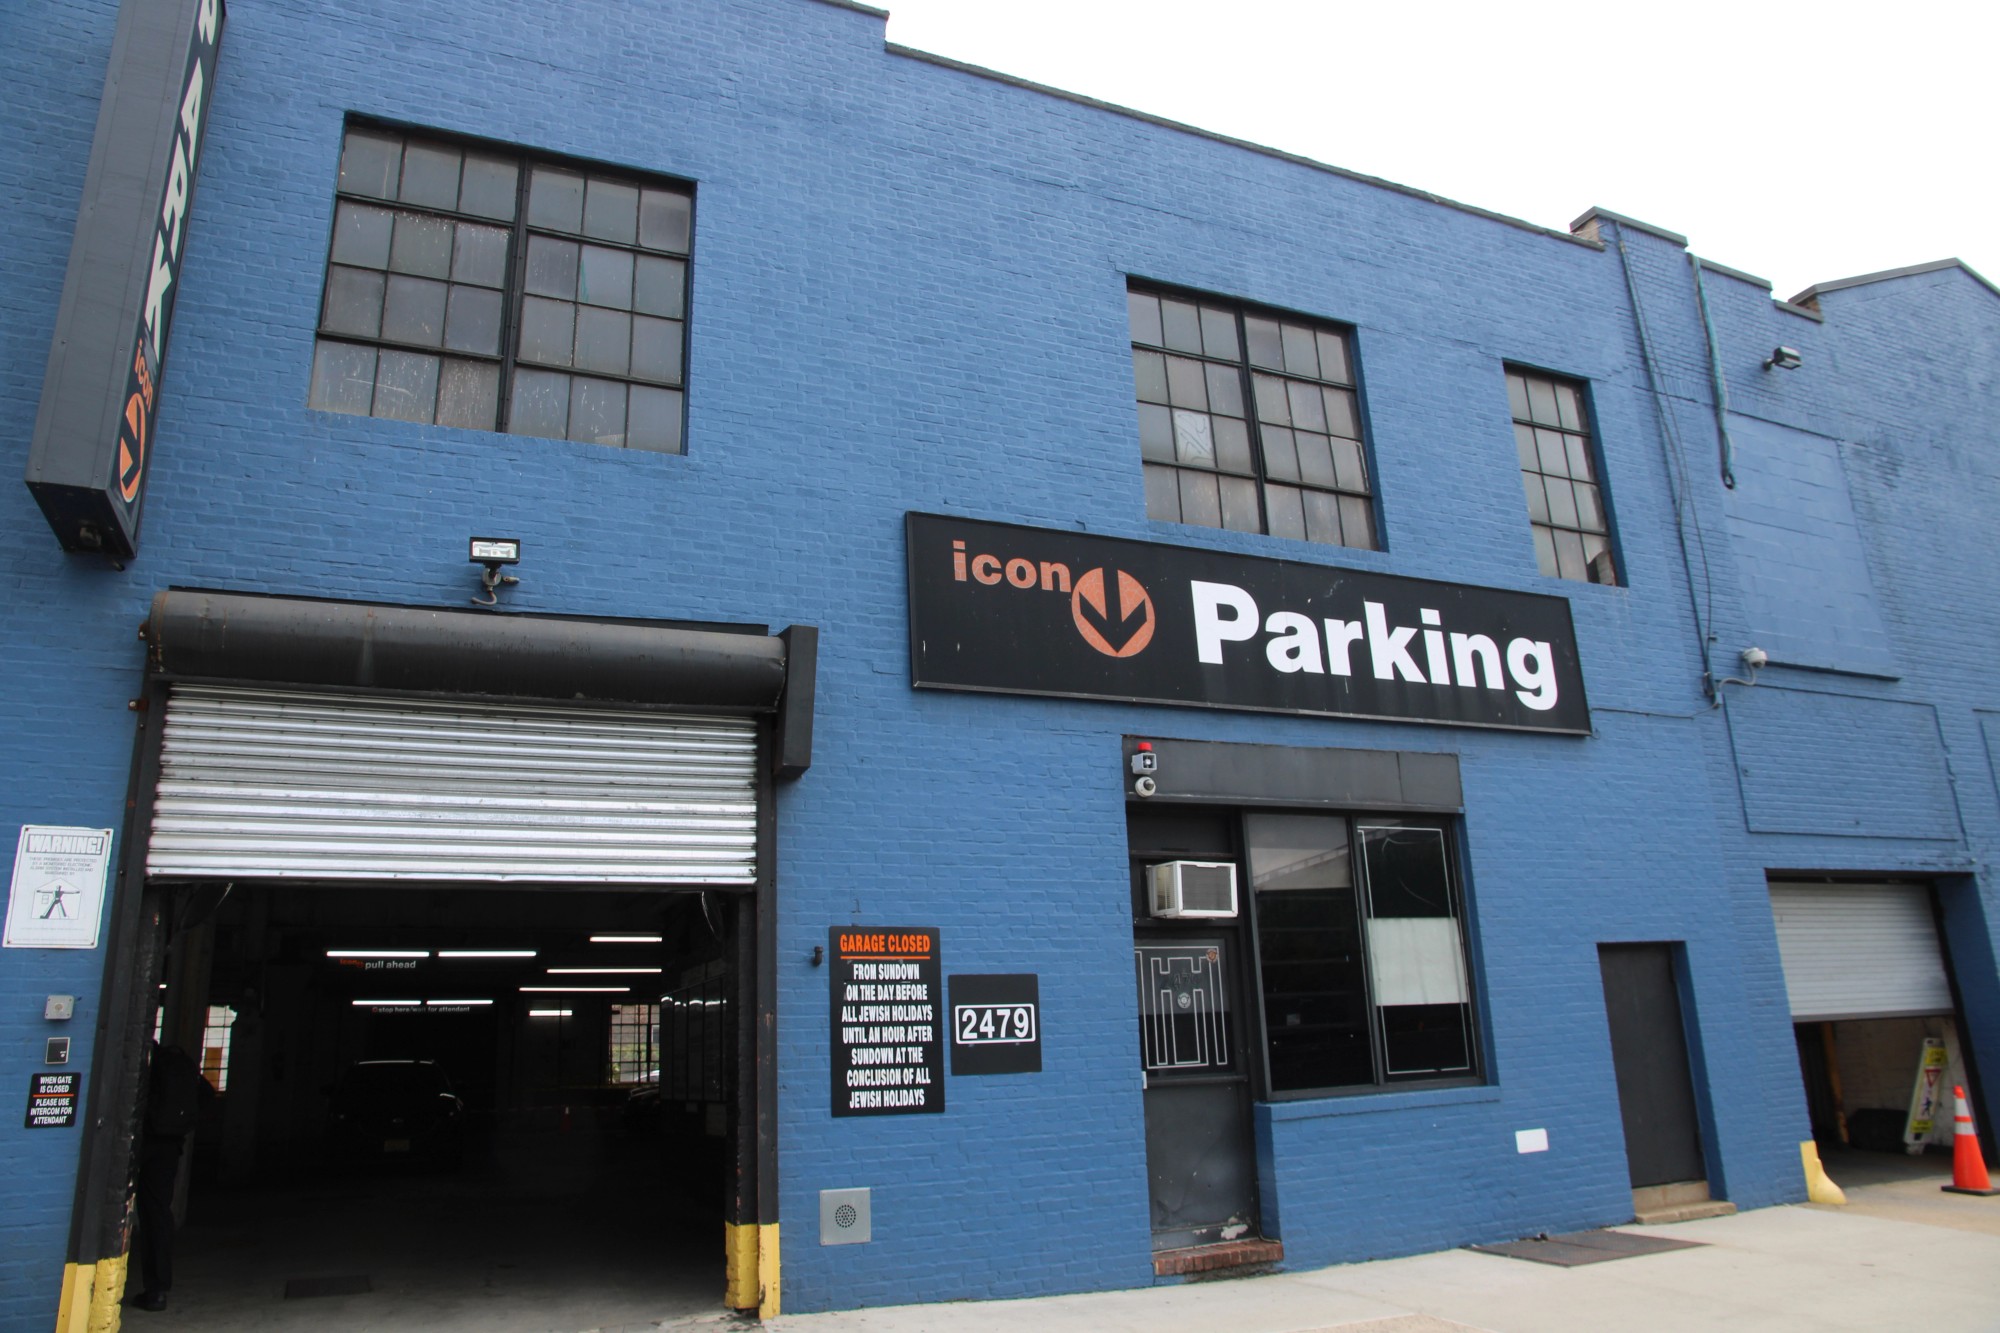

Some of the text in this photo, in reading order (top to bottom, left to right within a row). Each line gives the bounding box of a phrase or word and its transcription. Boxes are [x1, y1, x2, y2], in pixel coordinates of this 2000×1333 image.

[134, 338, 154, 413] icon
[952, 540, 1072, 592] icon
[1190, 579, 1559, 711] Parking
[28, 834, 103, 854] WARNING!
[840, 934, 931, 952] GARAGE CLOSED
[365, 960, 384, 970] pull
[386, 960, 416, 969] ahead
[853, 963, 920, 980] FROM SUNDOWN
[846, 984, 928, 1001] ON THE DAY BEFORE
[841, 1005, 933, 1022] ALL JEWISH HOLIDAYS
[961, 1007, 1030, 1039] 2479
[842, 1025, 933, 1044] UNTIL AN HOUR AFTER
[851, 1046, 923, 1065] SUNDOWN AT THE
[40, 1075, 73, 1084] WHEN GATE
[846, 1067, 931, 1087] CONCLUSION OF ALL
[40, 1085, 70, 1093] IS CLOSED
[35, 1098, 71, 1106] PLEASE USE
[849, 1089, 925, 1109] JEWISH HOLIDAYS
[30, 1107, 73, 1116] INTERCOM FOR
[33, 1116, 67, 1125] ATTENDANT
